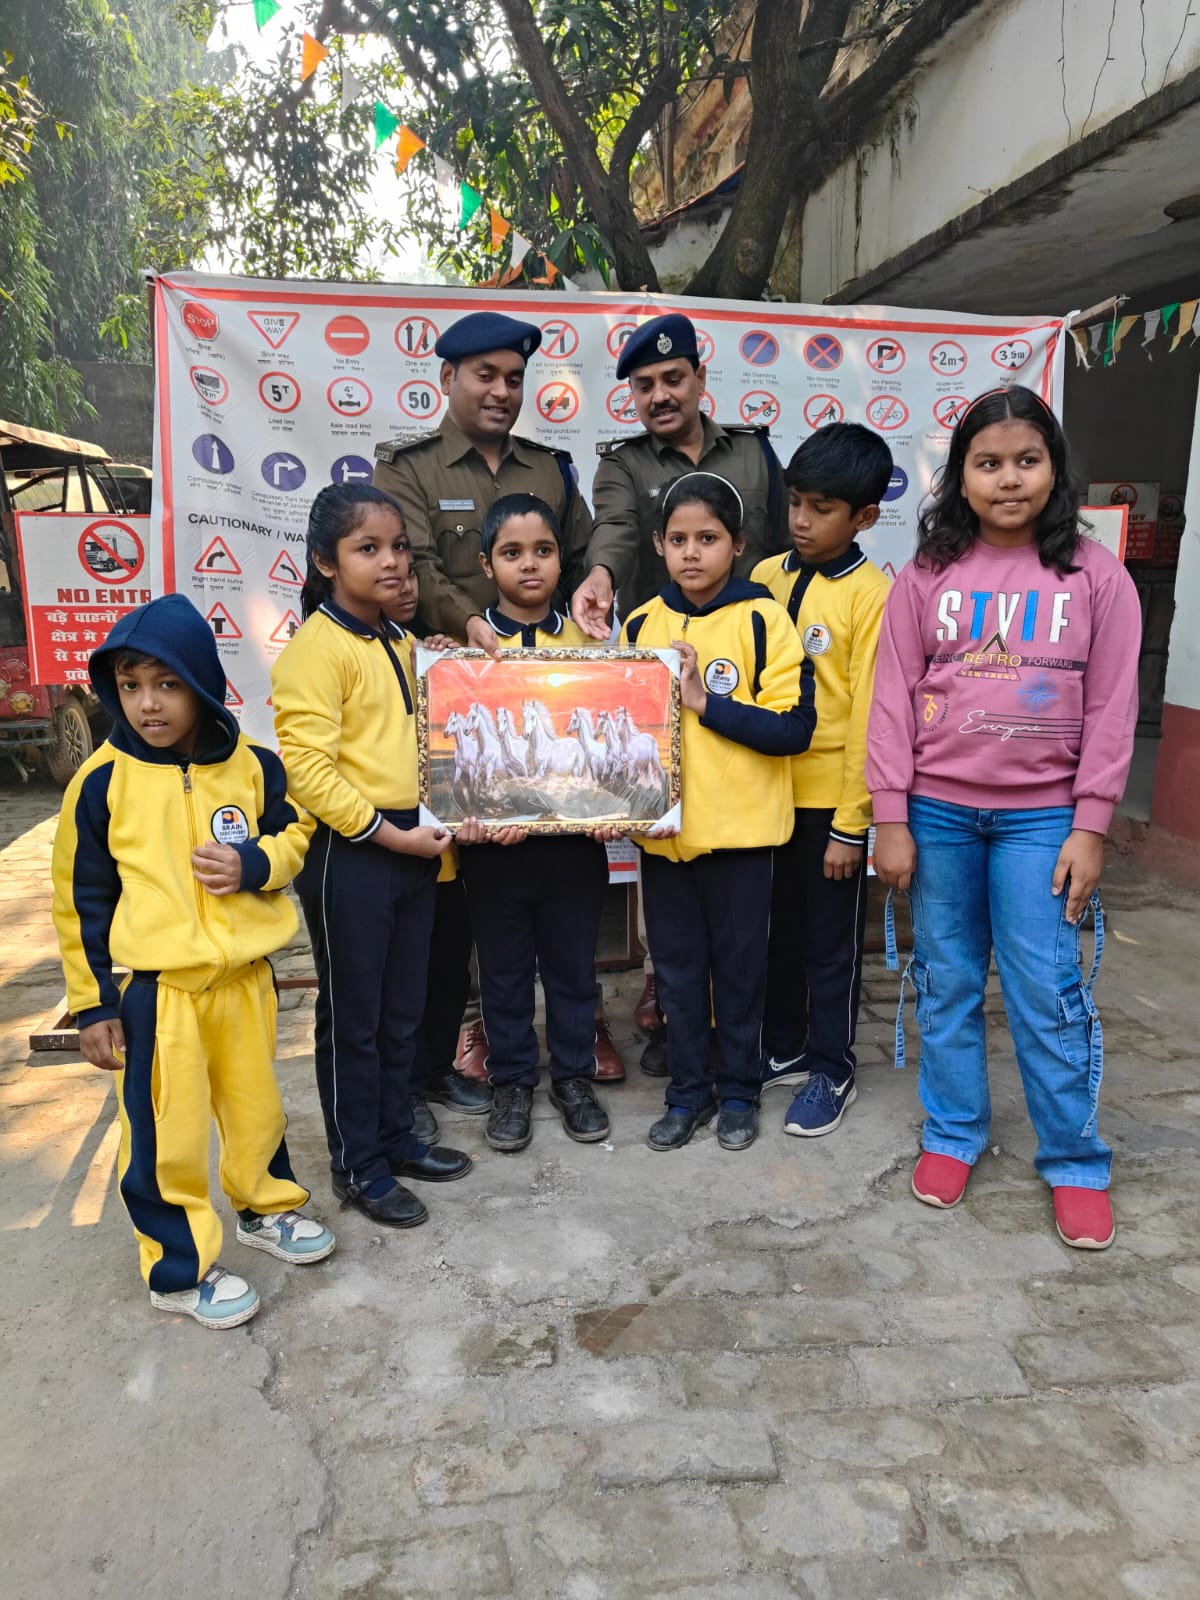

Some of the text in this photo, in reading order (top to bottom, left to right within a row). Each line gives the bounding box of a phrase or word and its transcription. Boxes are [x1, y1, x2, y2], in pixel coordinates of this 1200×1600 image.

[187, 313, 215, 328] STOP
[263, 318, 285, 327] GIVE
[408, 391, 431, 410] 50
[188, 513, 272, 537] CAUTIONARY
[284, 531, 306, 542] WA
[57, 588, 151, 604] NO ENTR
[45, 609, 68, 625] बड़े
[53, 649, 68, 662] से
[962, 653, 1022, 668] RETRO
[64, 668, 89, 681] प्रवे
